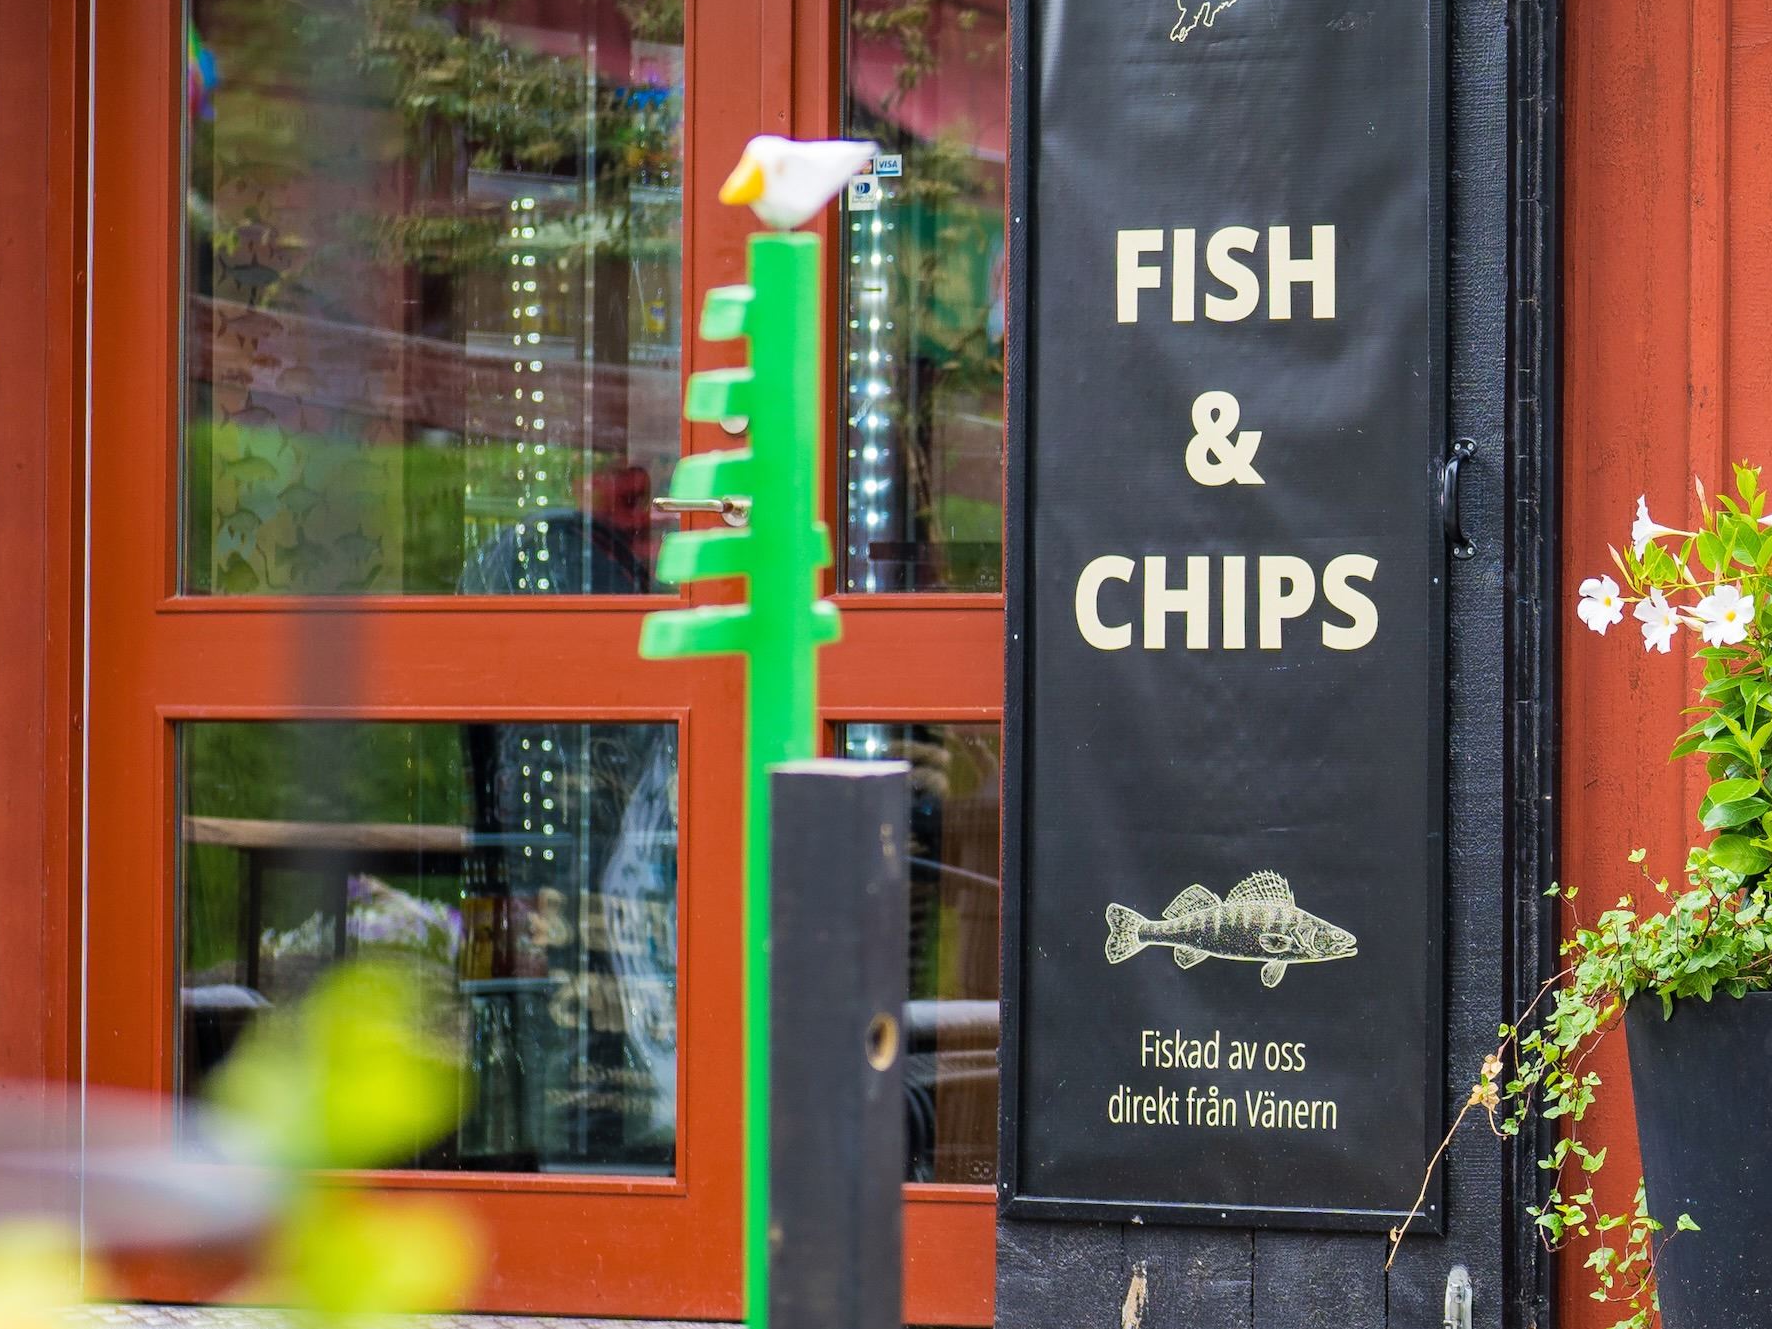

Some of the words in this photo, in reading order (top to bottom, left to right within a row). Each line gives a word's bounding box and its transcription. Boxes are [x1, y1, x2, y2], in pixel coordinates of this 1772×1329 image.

[878, 159, 898, 169] VISA
[1115, 223, 1337, 325] FISH
[1184, 389, 1267, 487] &
[1074, 552, 1380, 652] CHIPS
[1140, 1027, 1222, 1071] Fiskad
[1227, 1039, 1259, 1072] av
[1263, 1040, 1307, 1073] oss
[1107, 1083, 1181, 1127] direkt
[1184, 1084, 1238, 1128] från
[1244, 1089, 1338, 1131] Vänern
